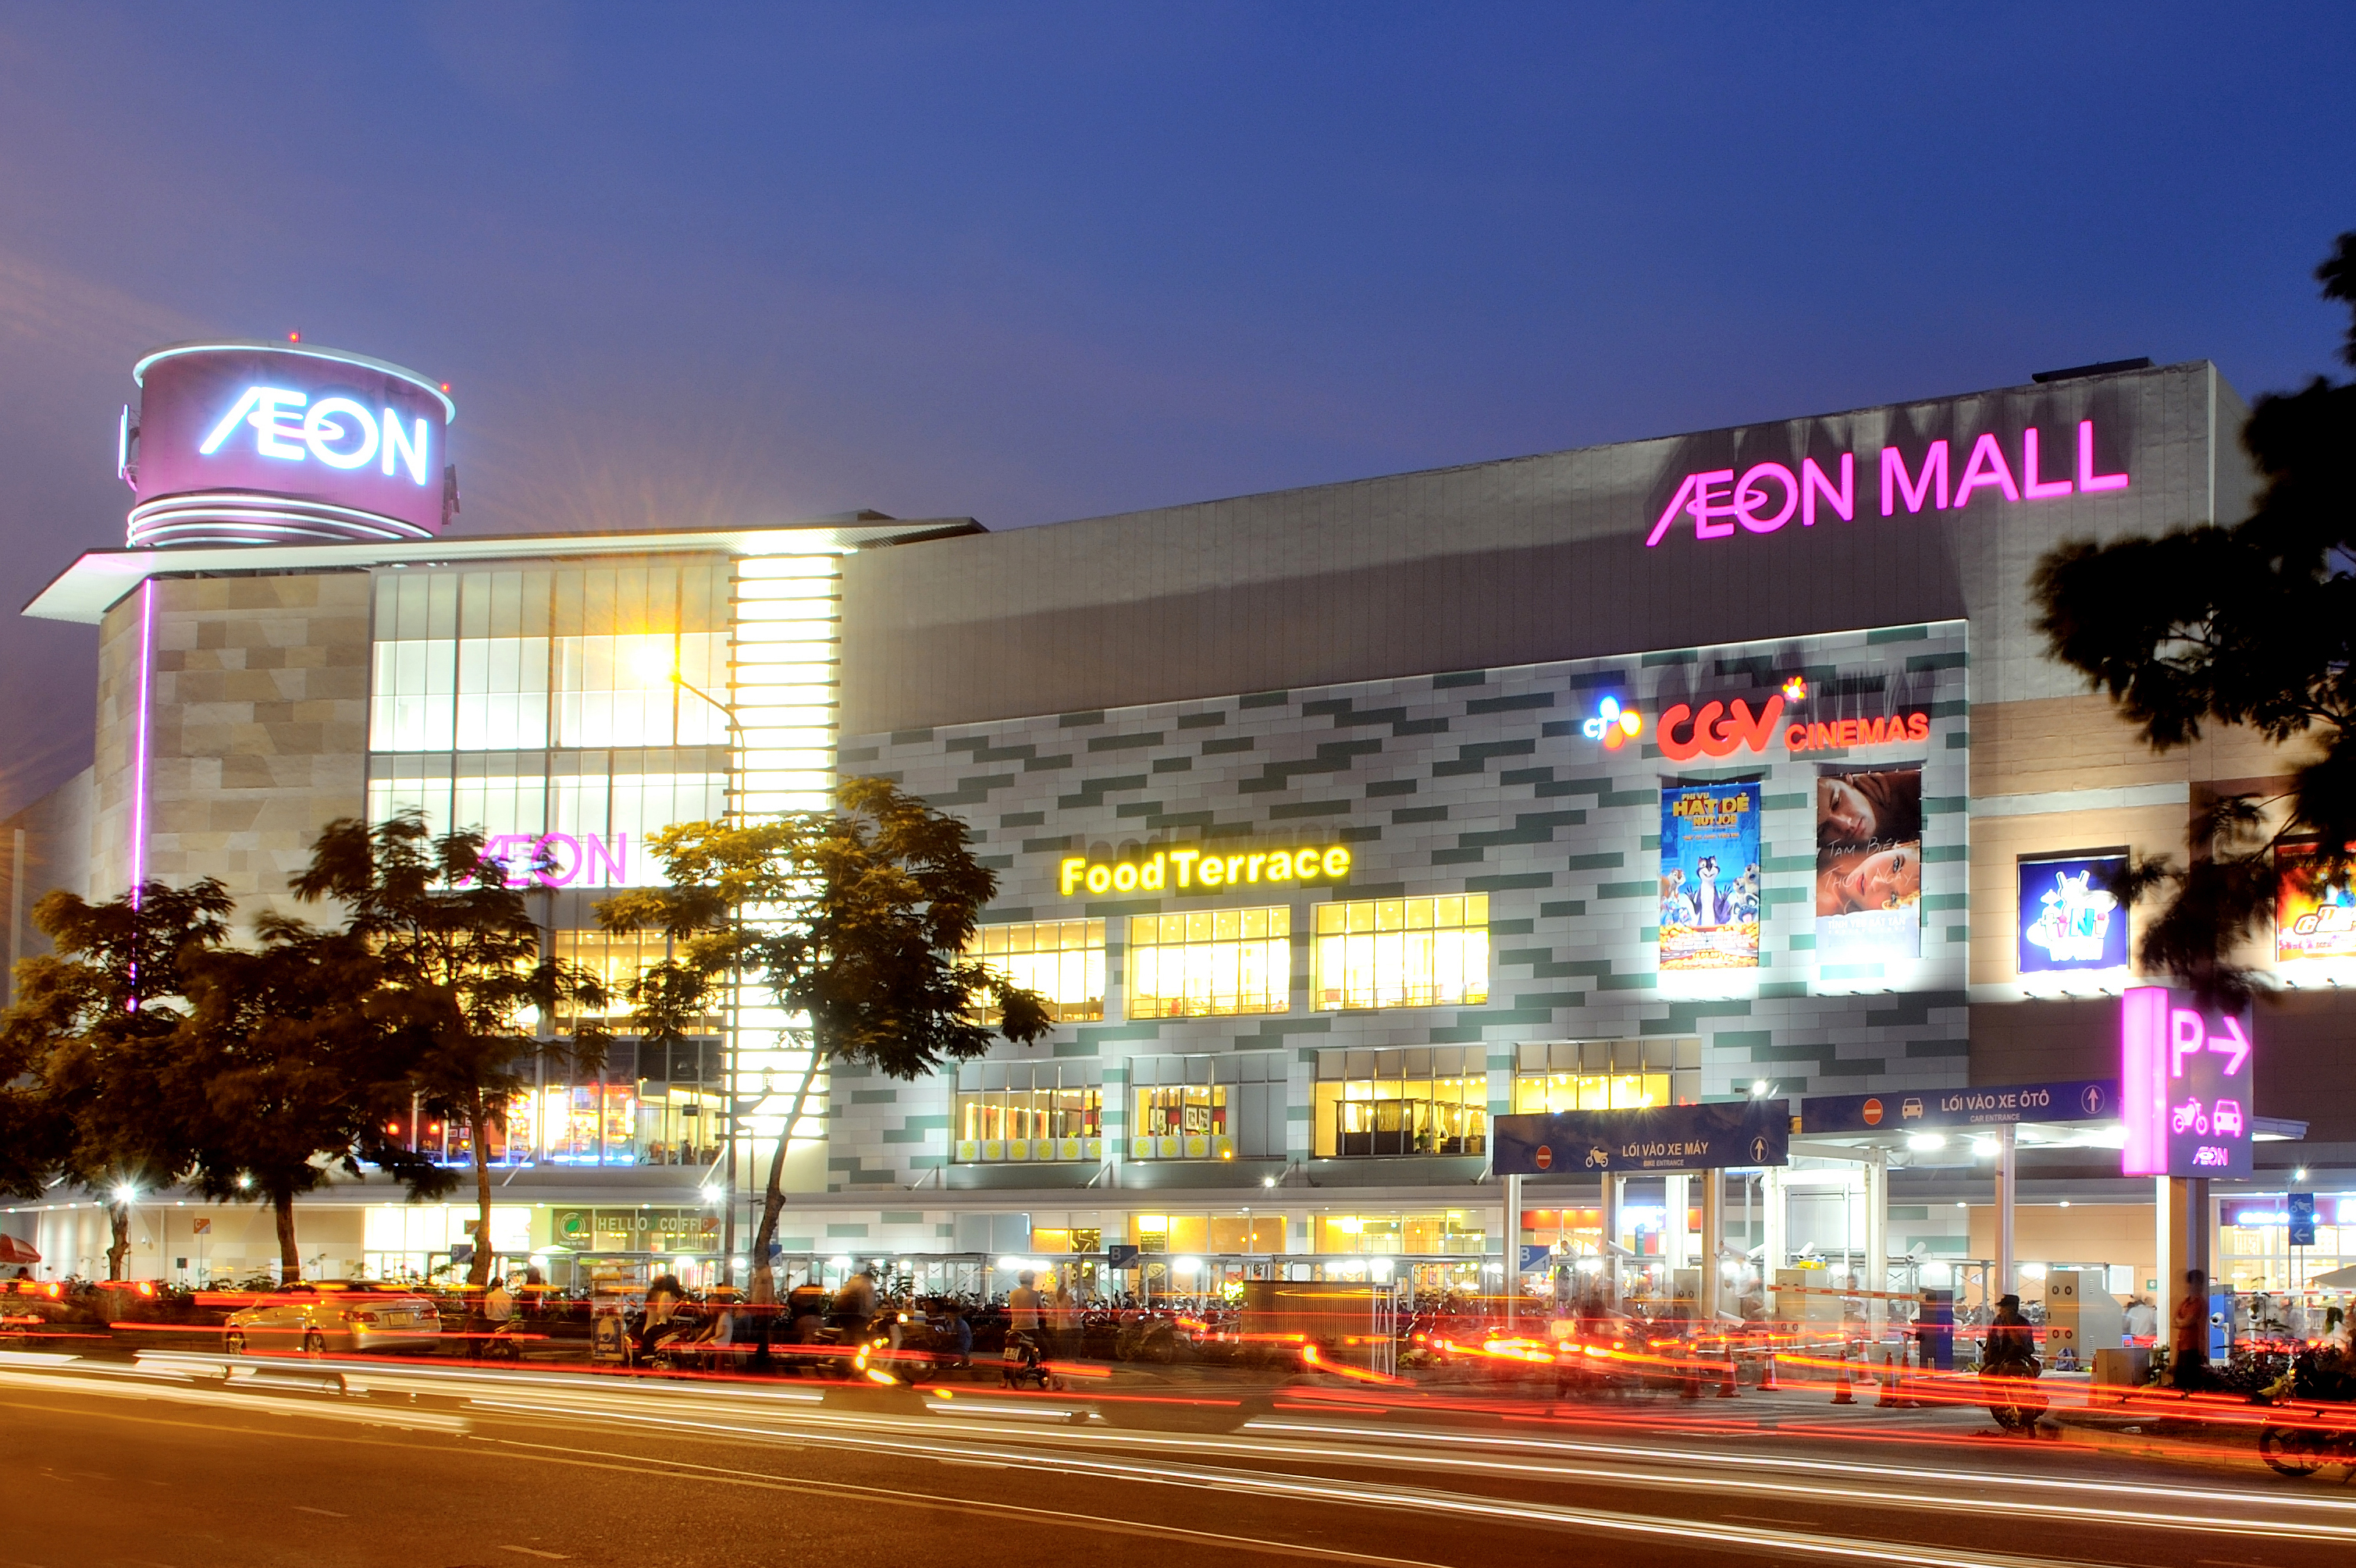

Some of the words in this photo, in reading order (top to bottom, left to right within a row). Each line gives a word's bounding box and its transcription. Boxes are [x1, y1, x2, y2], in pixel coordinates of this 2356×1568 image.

[1881, 420, 2130, 516] MALL
[1656, 694, 1785, 760] CGV
[1785, 712, 1930, 752] CINEMAS
[1692, 816, 1715, 826] NUT
[1716, 813, 1738, 824] JOB
[1061, 852, 1166, 895] Food
[1169, 846, 1351, 887] Terrace
[2170, 1008, 2206, 1079] P
[1941, 1094, 1963, 1111] LỐI
[1966, 1093, 1995, 1110] VÀO
[1998, 1094, 2016, 1109] XE
[2020, 1089, 2050, 1108] ÔTÔ
[1985, 1113, 2020, 1122] ENTRANCE
[1622, 1141, 1639, 1157] LỐI
[1642, 1140, 1664, 1156] VÀO
[1667, 1143, 1682, 1156] XE
[1685, 1140, 1709, 1155] MÁY
[598, 1217, 648, 1231] HELLO
[660, 1217, 702, 1231] COFF
[1112, 1246, 1121, 1260] B
[1521, 1247, 1530, 1261] B
